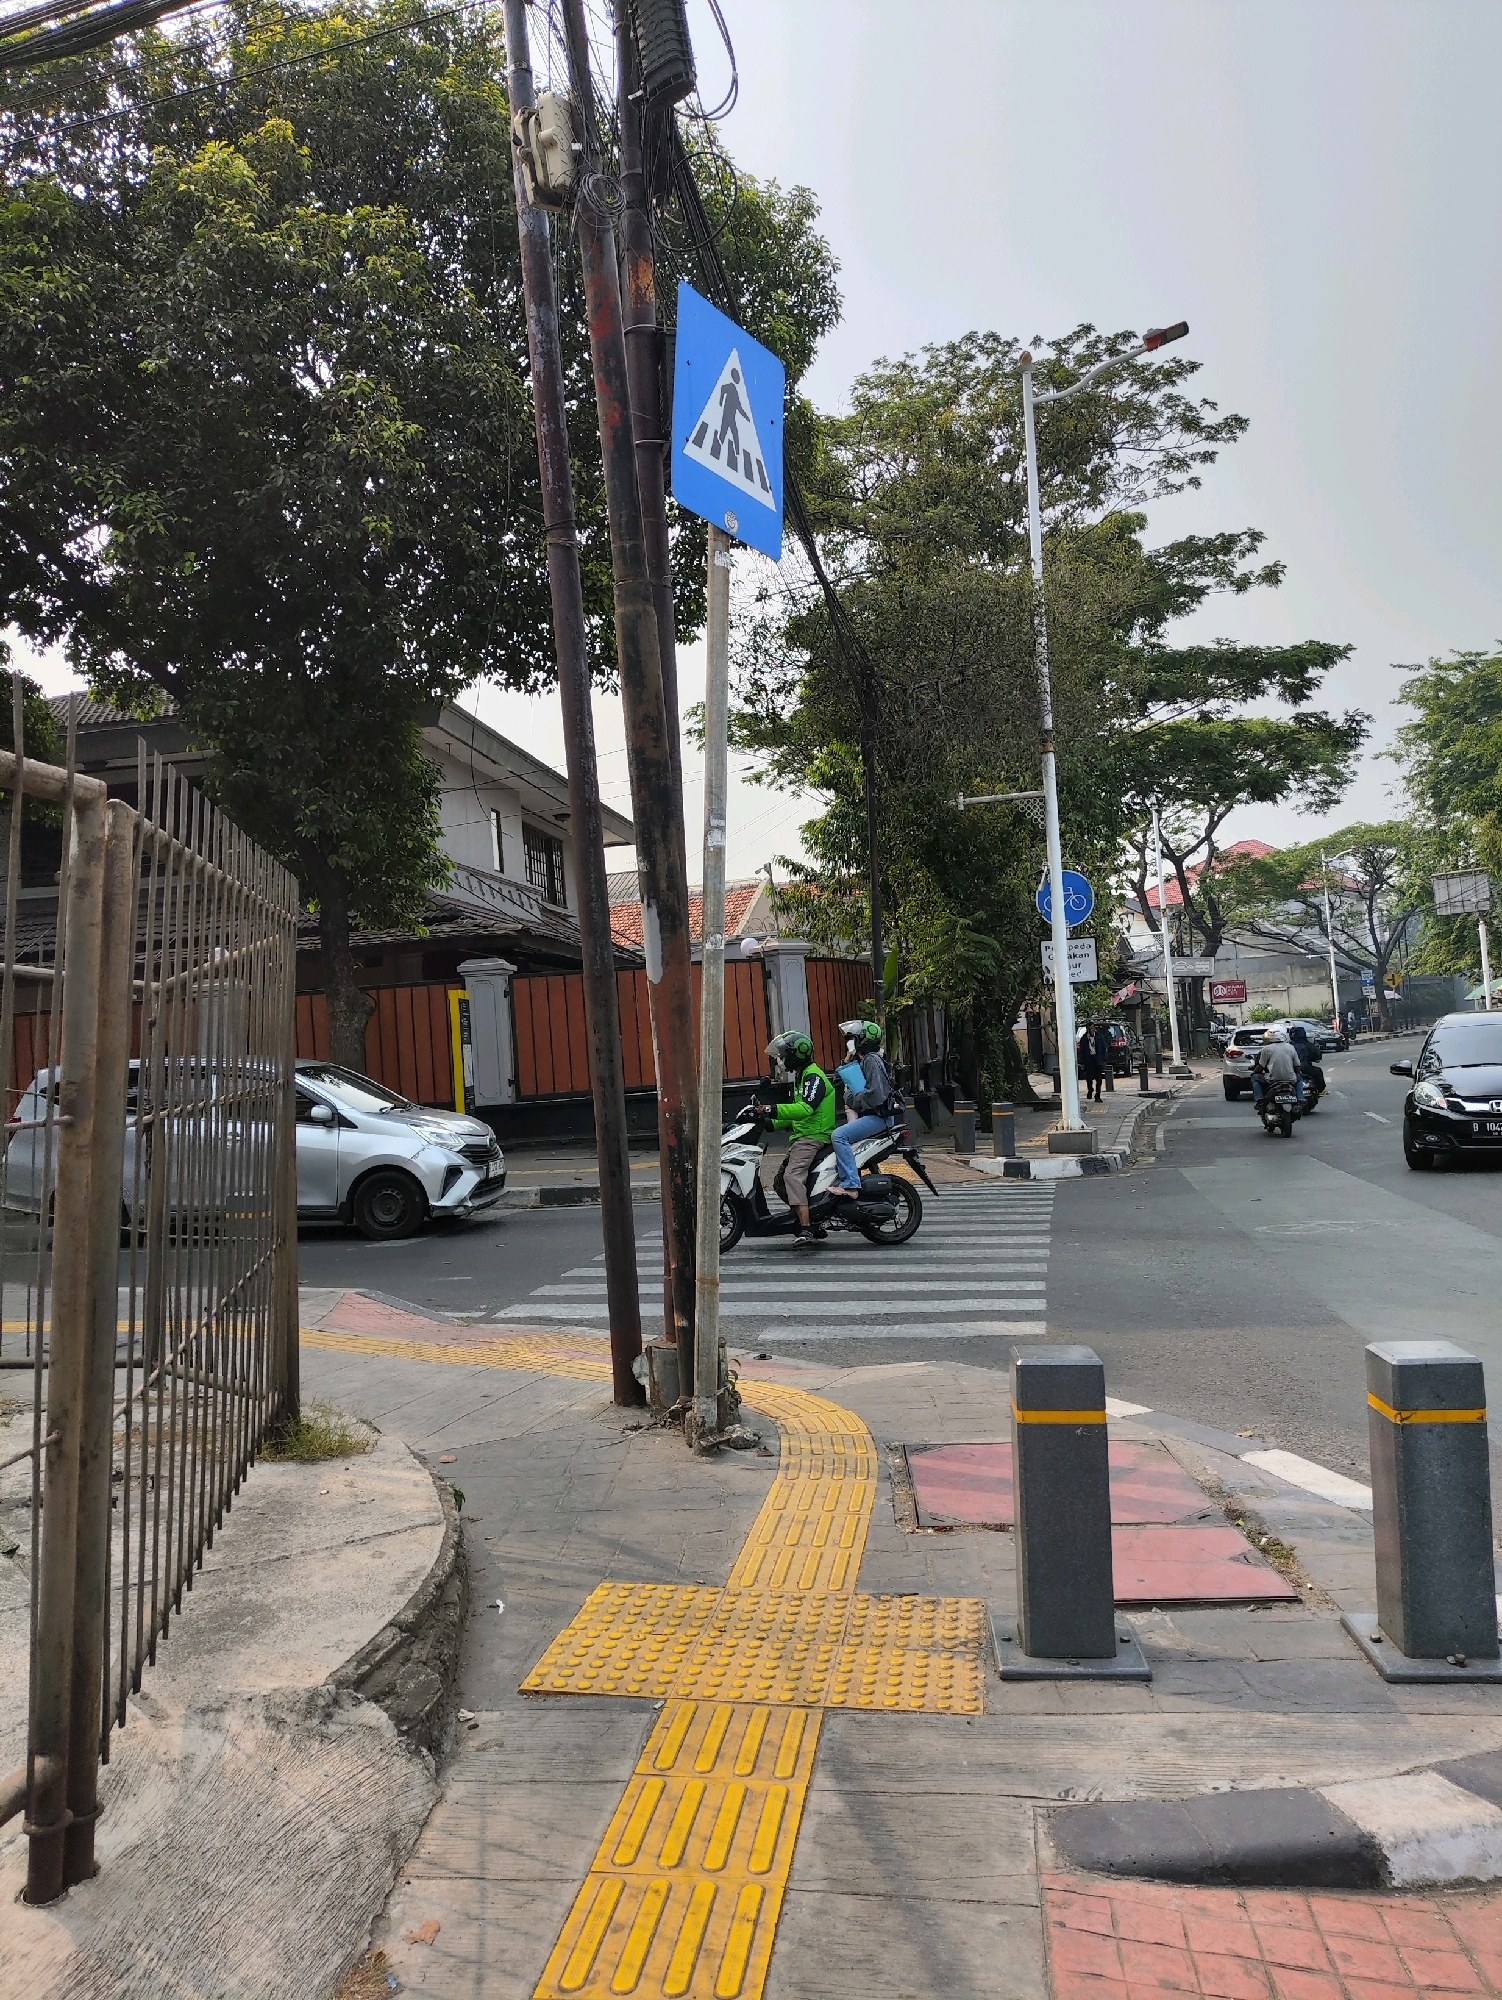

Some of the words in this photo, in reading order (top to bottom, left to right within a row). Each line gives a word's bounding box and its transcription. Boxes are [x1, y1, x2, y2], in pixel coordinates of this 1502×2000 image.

[1045, 943, 1091, 952] Ppeda
[1048, 952, 1090, 960] Gakan
[1473, 1123, 1478, 1132] B
